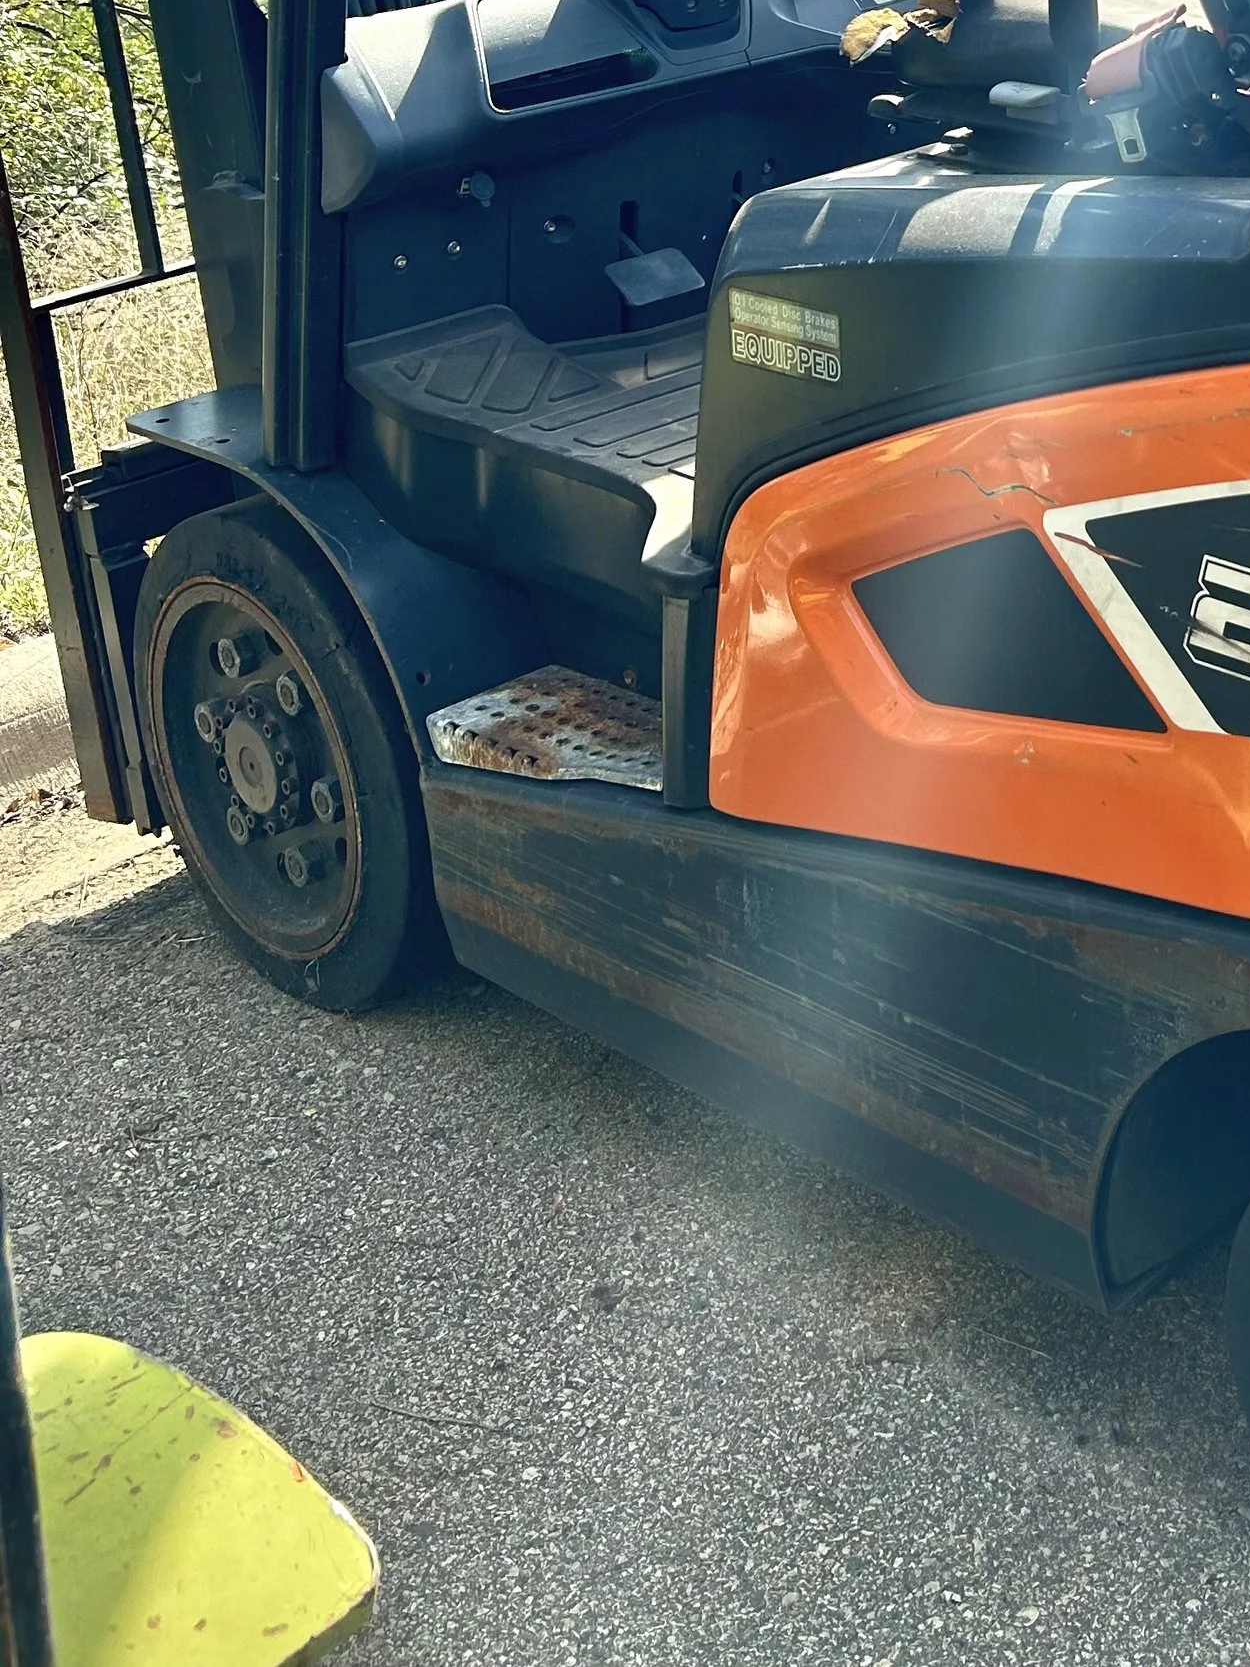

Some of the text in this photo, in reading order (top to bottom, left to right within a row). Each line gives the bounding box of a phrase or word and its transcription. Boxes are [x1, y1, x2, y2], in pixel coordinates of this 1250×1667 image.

[735, 306, 837, 344] Operator Sensing System
[748, 297, 778, 315] Cooled
[782, 305, 801, 321] Disc
[804, 310, 836, 330] Brakes
[731, 329, 841, 382] EQUIPPED
